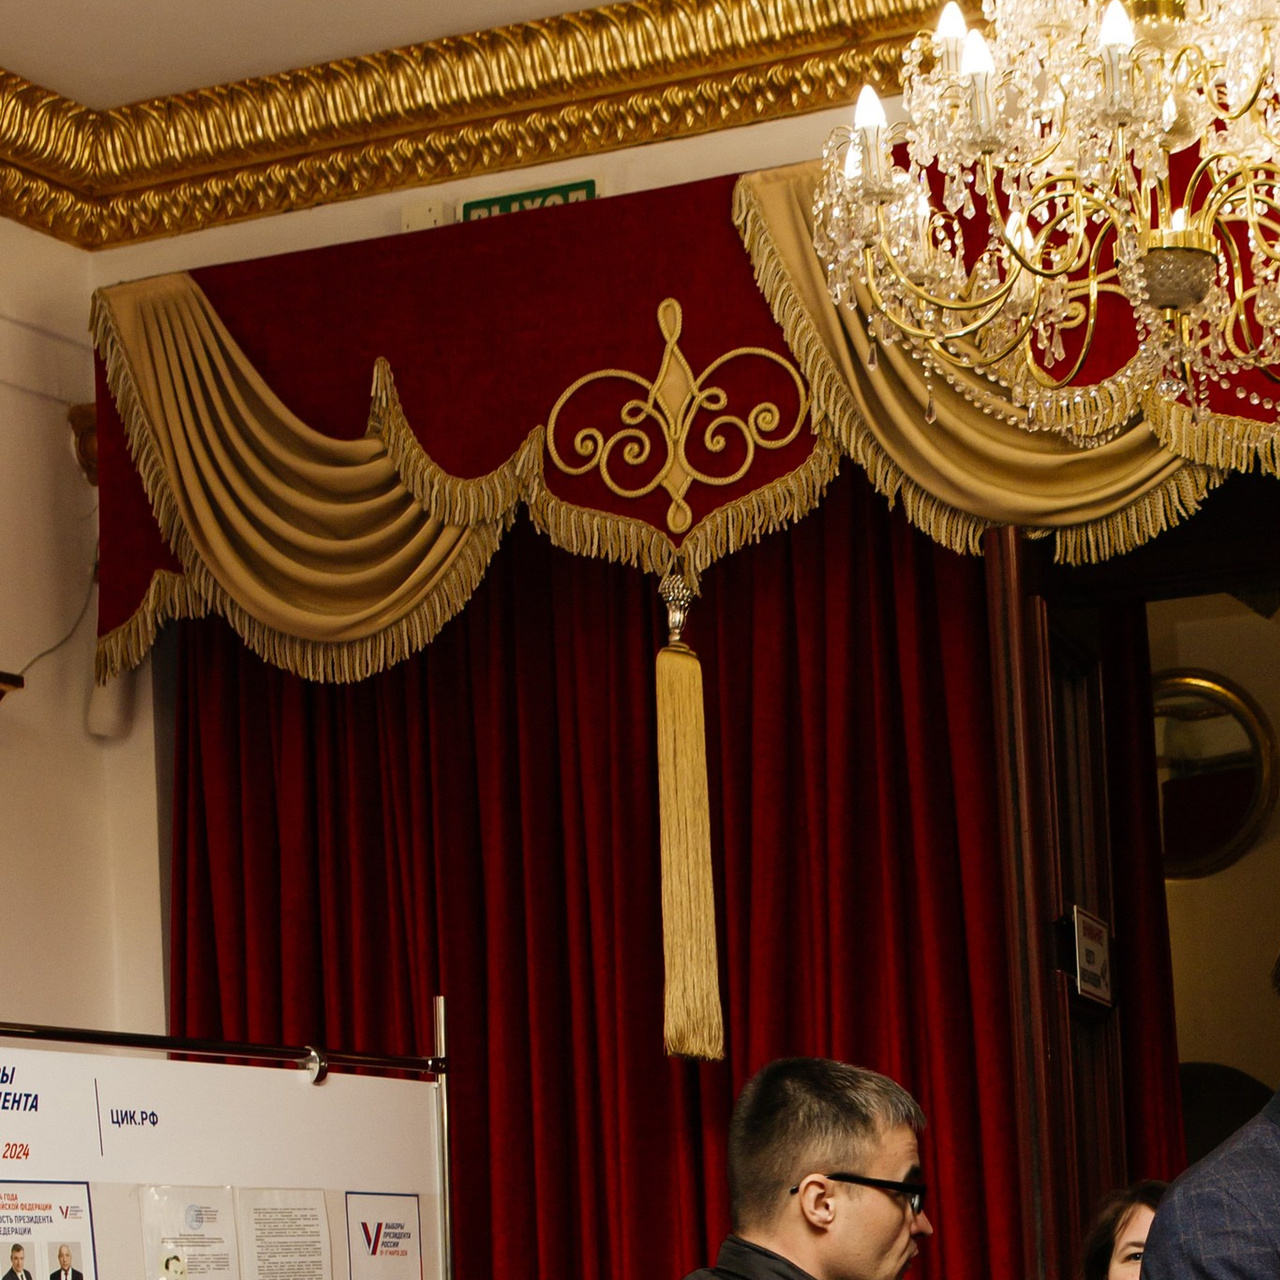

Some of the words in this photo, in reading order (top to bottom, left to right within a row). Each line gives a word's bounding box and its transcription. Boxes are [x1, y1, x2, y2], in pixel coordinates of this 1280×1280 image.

[0, 1066, 15, 1085] Ы
[0, 1091, 39, 1112] ЕНТА
[110, 1109, 159, 1128] ЦИК.РФ
[2, 1142, 30, 1160] 2024
[20, 1203, 52, 1211] ФЕДЕРАЦИИ
[14, 1215, 54, 1225] ПРЕЗИДЕНТА
[384, 1222, 405, 1230] ВЫБОРЫ
[383, 1231, 411, 1239] ПРЕЗИДЕНТА
[381, 1240, 400, 1248] РОССИИ
